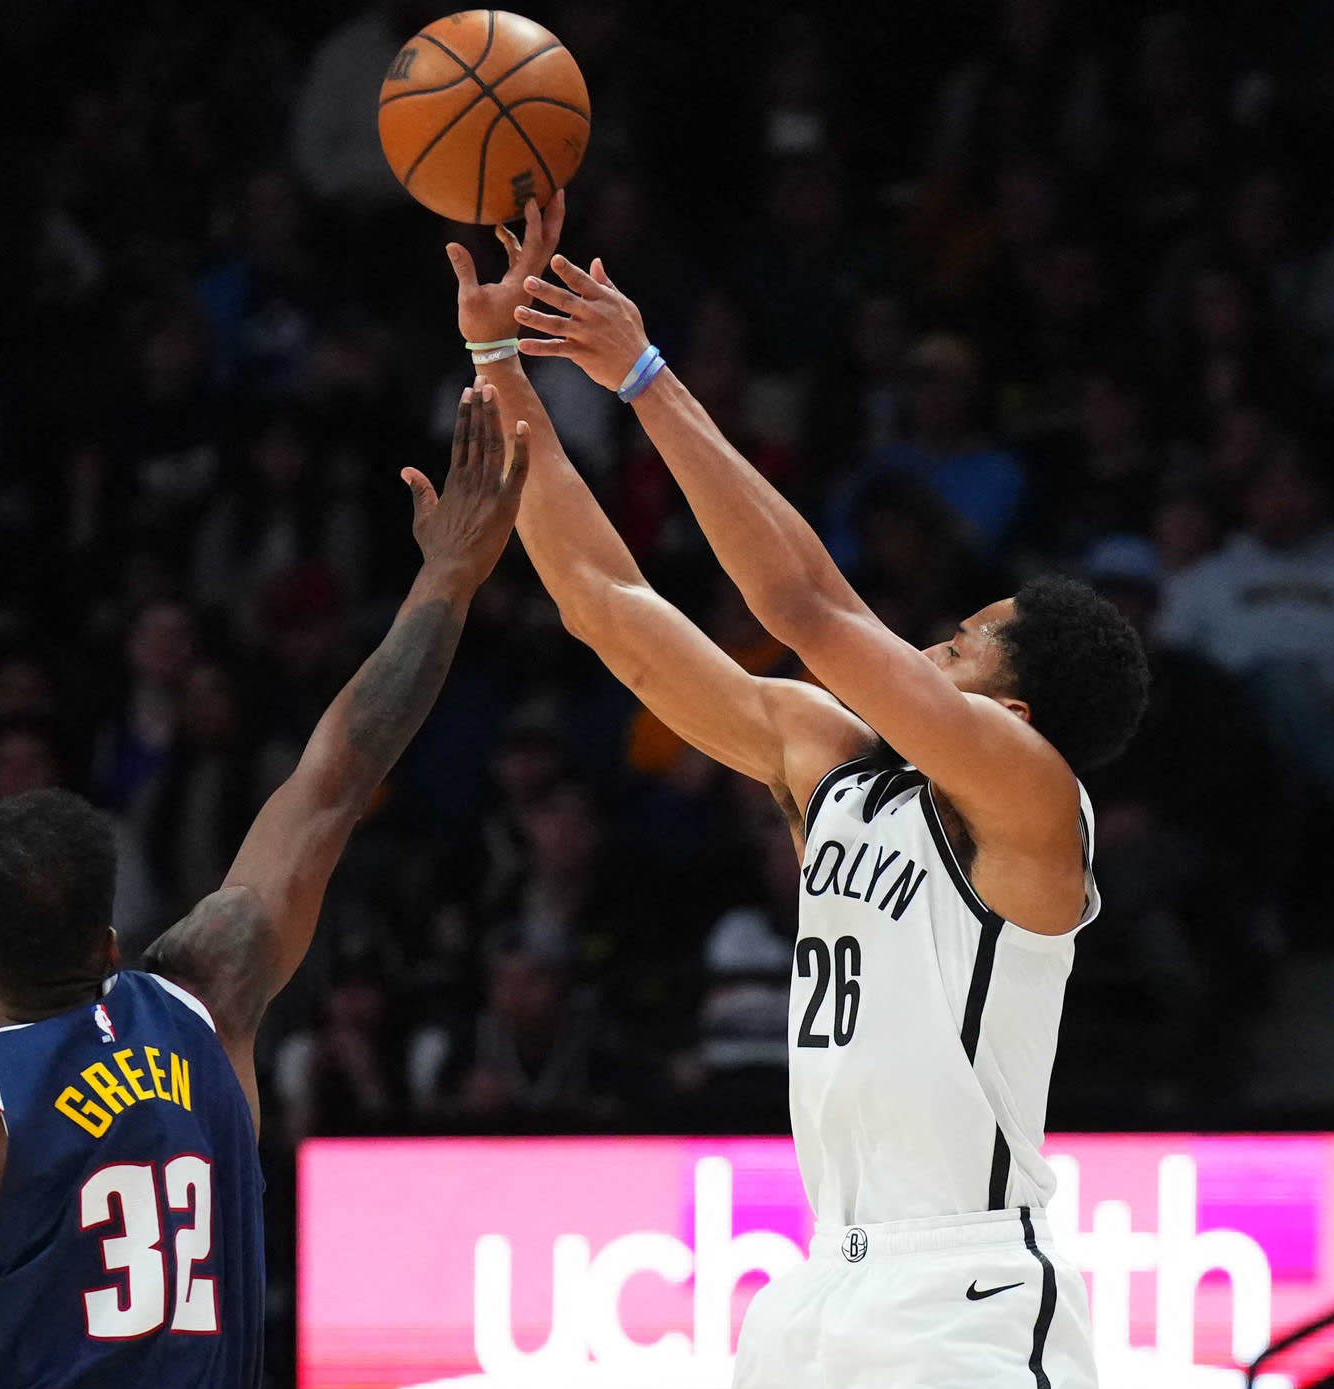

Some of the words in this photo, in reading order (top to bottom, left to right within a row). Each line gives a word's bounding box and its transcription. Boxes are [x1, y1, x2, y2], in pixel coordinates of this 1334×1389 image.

[796, 935, 862, 1048] 26
[54, 1045, 193, 1139] GREEN
[79, 1152, 222, 1342] 32
